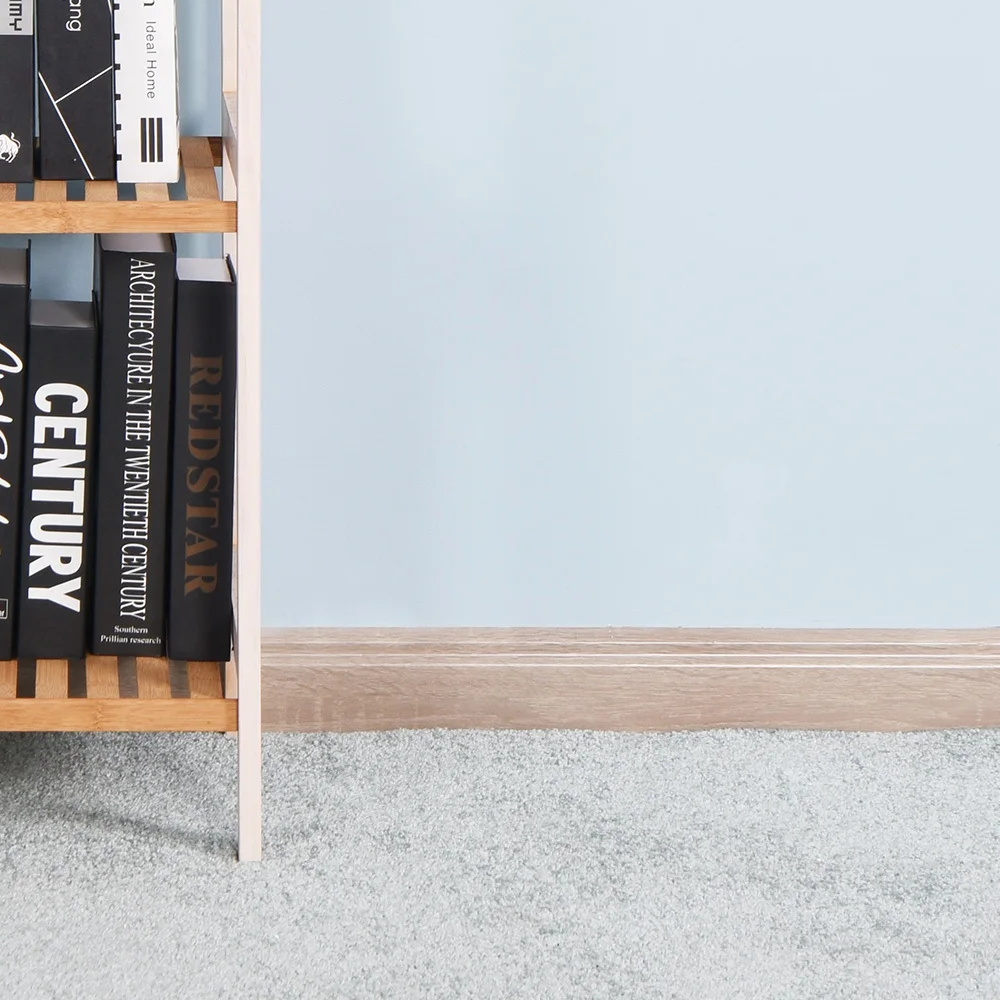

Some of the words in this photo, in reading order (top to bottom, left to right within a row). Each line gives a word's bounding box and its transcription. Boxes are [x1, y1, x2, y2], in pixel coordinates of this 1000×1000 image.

[145, 21, 156, 54] Ideal
[146, 60, 157, 99] Home
[126, 258, 156, 385] ARCHITECYURE
[126, 388, 152, 406] IN
[124, 410, 152, 442] THE
[122, 445, 151, 540] TWENTIETH
[184, 352, 223, 597] REDSTAR
[27, 382, 90, 613] CENTURY
[119, 543, 148, 621] CENTURY
[114, 625, 149, 634] Southern
[129, 635, 162, 645] research
